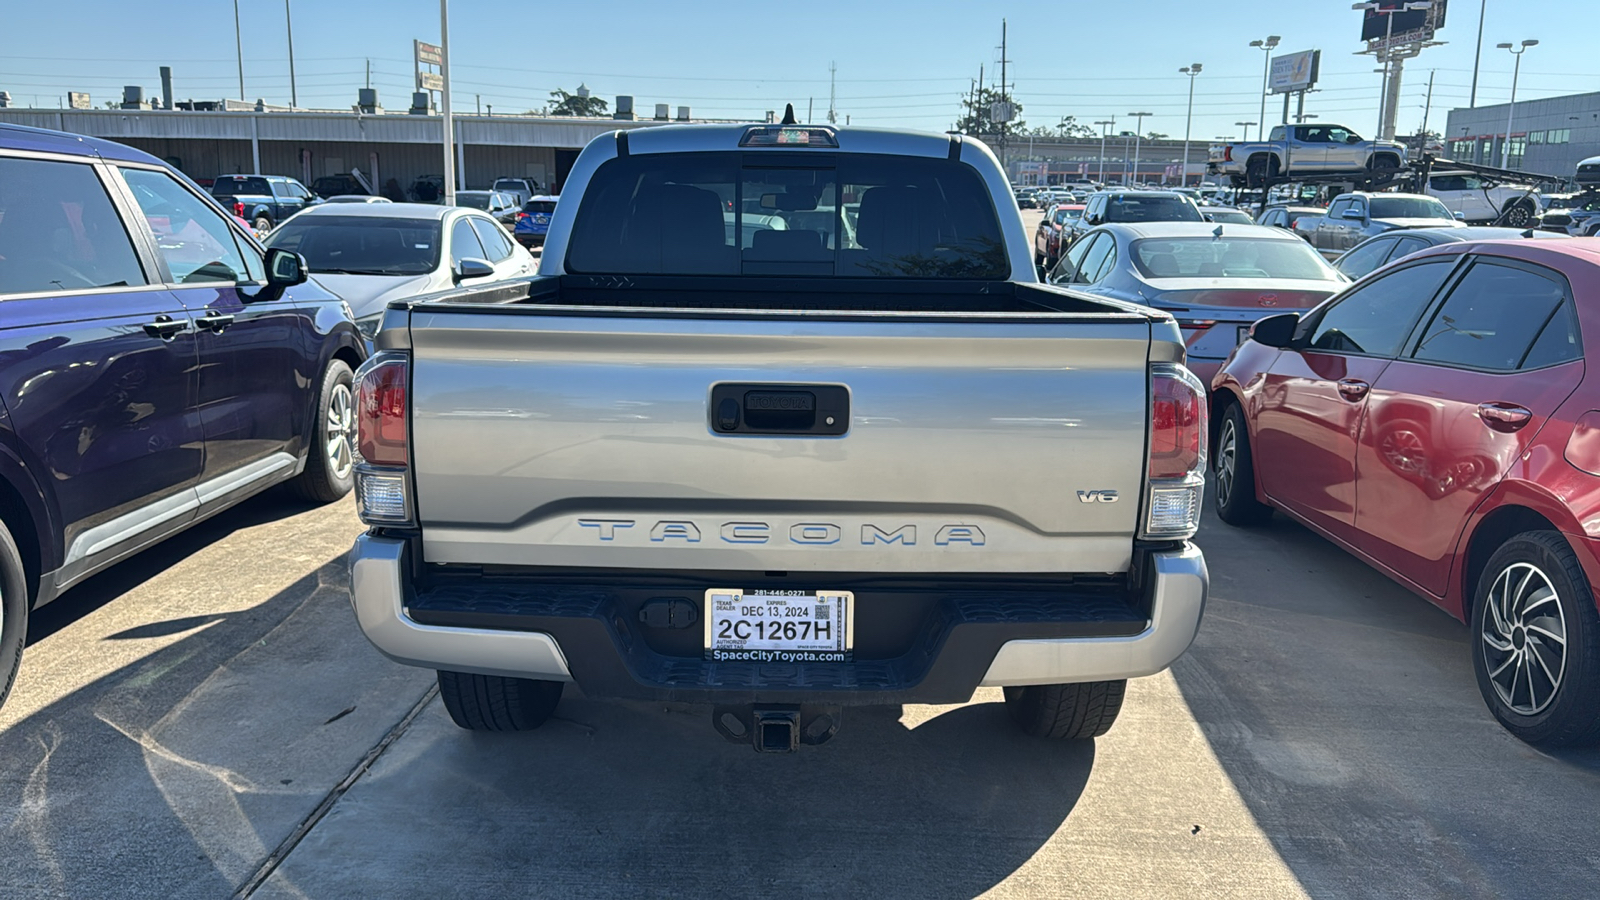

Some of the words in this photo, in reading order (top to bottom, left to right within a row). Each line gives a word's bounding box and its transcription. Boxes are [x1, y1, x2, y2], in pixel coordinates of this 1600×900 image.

[751, 396, 809, 409] TOYOTA
[1076, 490, 1119, 503] V6
[578, 519, 986, 546] TACOMA
[741, 606, 764, 617] DEC
[767, 607, 782, 618] 13,
[785, 607, 809, 617] 2024
[717, 619, 831, 640] 2C1267H
[713, 650, 845, 662] SpaceCityToyota.com
